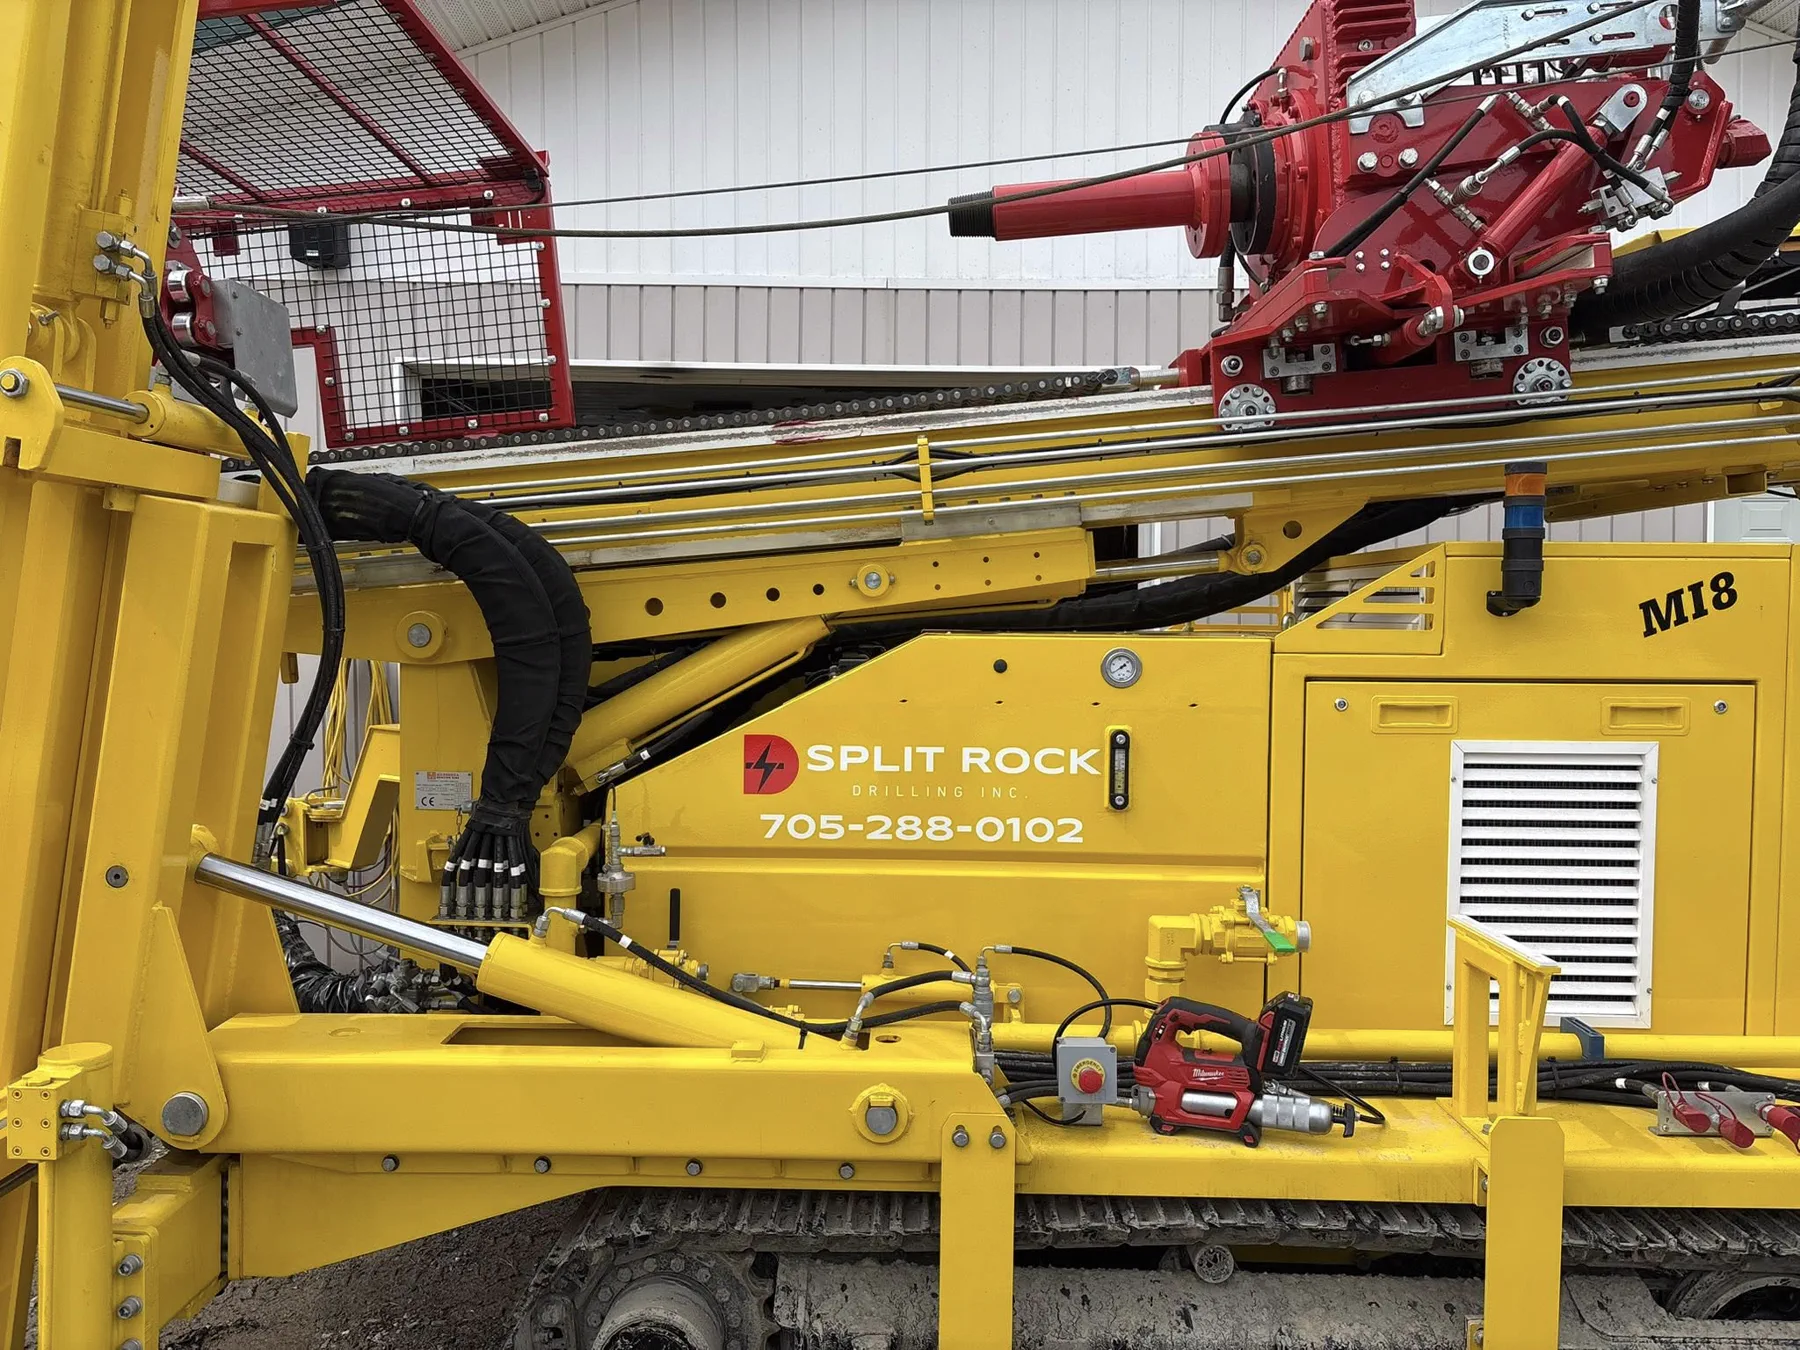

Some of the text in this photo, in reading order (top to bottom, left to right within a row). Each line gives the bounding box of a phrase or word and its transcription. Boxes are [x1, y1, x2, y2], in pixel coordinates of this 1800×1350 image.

[1638, 571, 1738, 638] MI8
[807, 744, 1101, 775] SPLIT ROCK
[852, 784, 1030, 799] DRILLING INC.
[760, 813, 1084, 844] 705-288-0102
